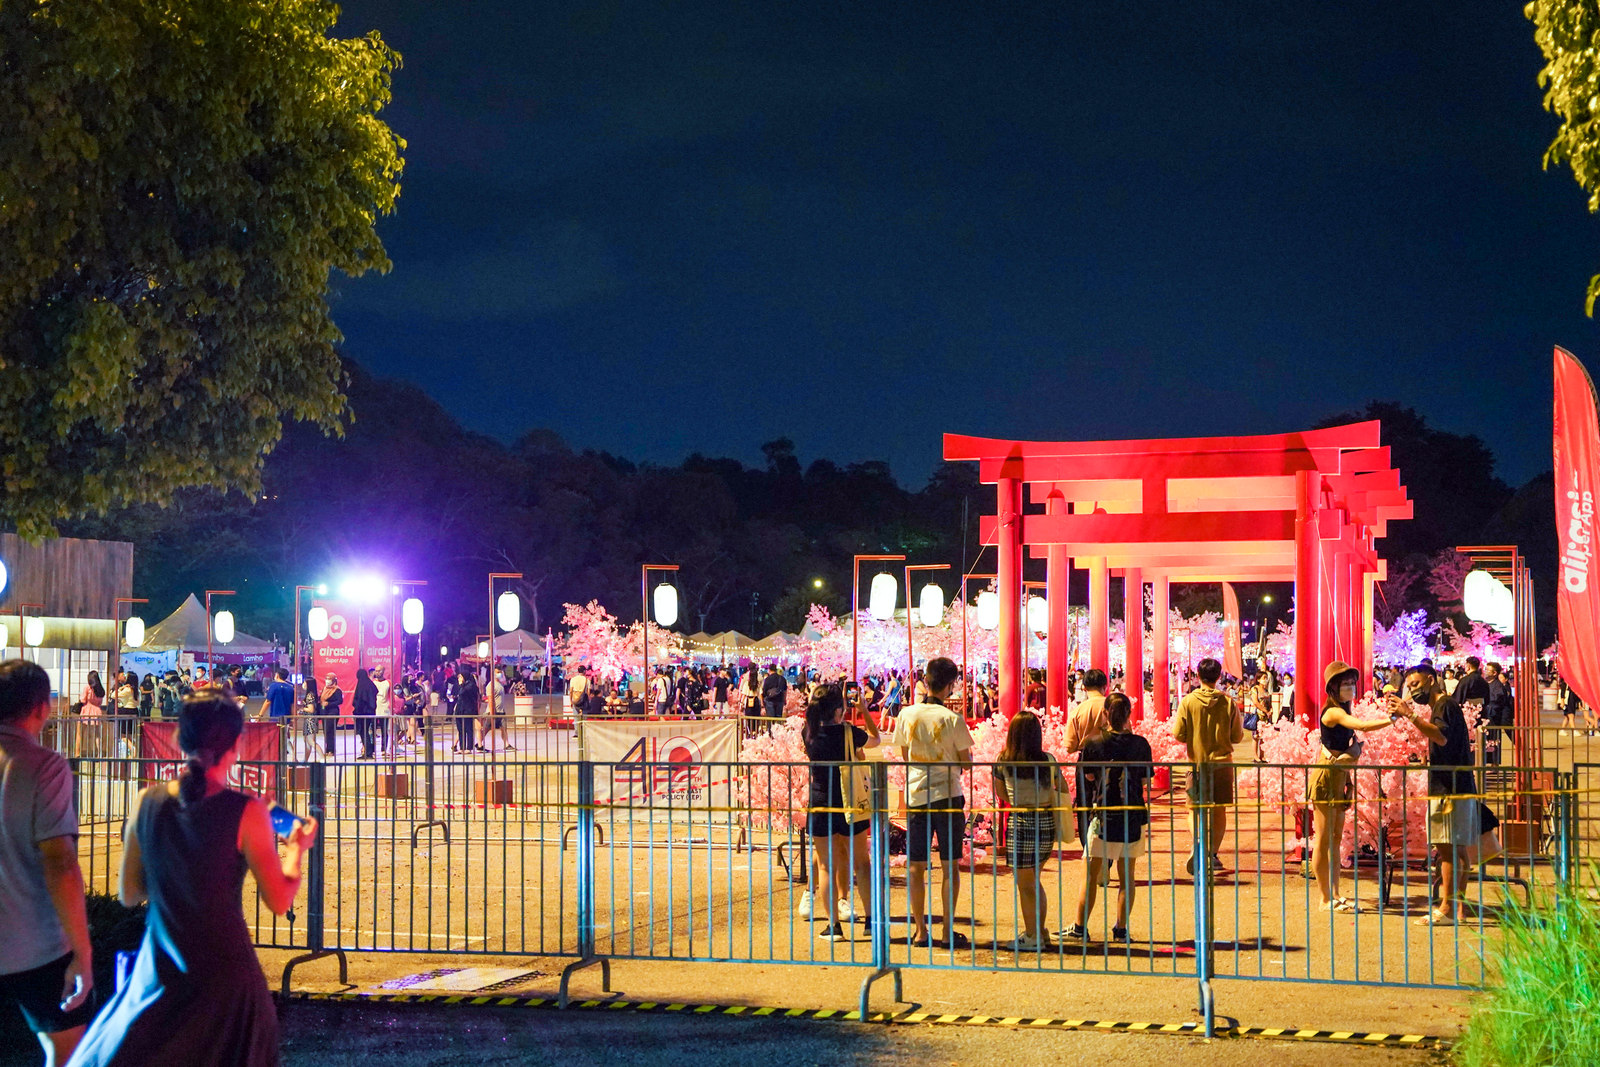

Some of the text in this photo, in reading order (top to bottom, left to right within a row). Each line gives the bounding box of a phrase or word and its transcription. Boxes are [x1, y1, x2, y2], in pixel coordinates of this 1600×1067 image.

[1581, 491, 1594, 526] App
[1562, 469, 1588, 593] airasi
[319, 645, 354, 656] airasia
